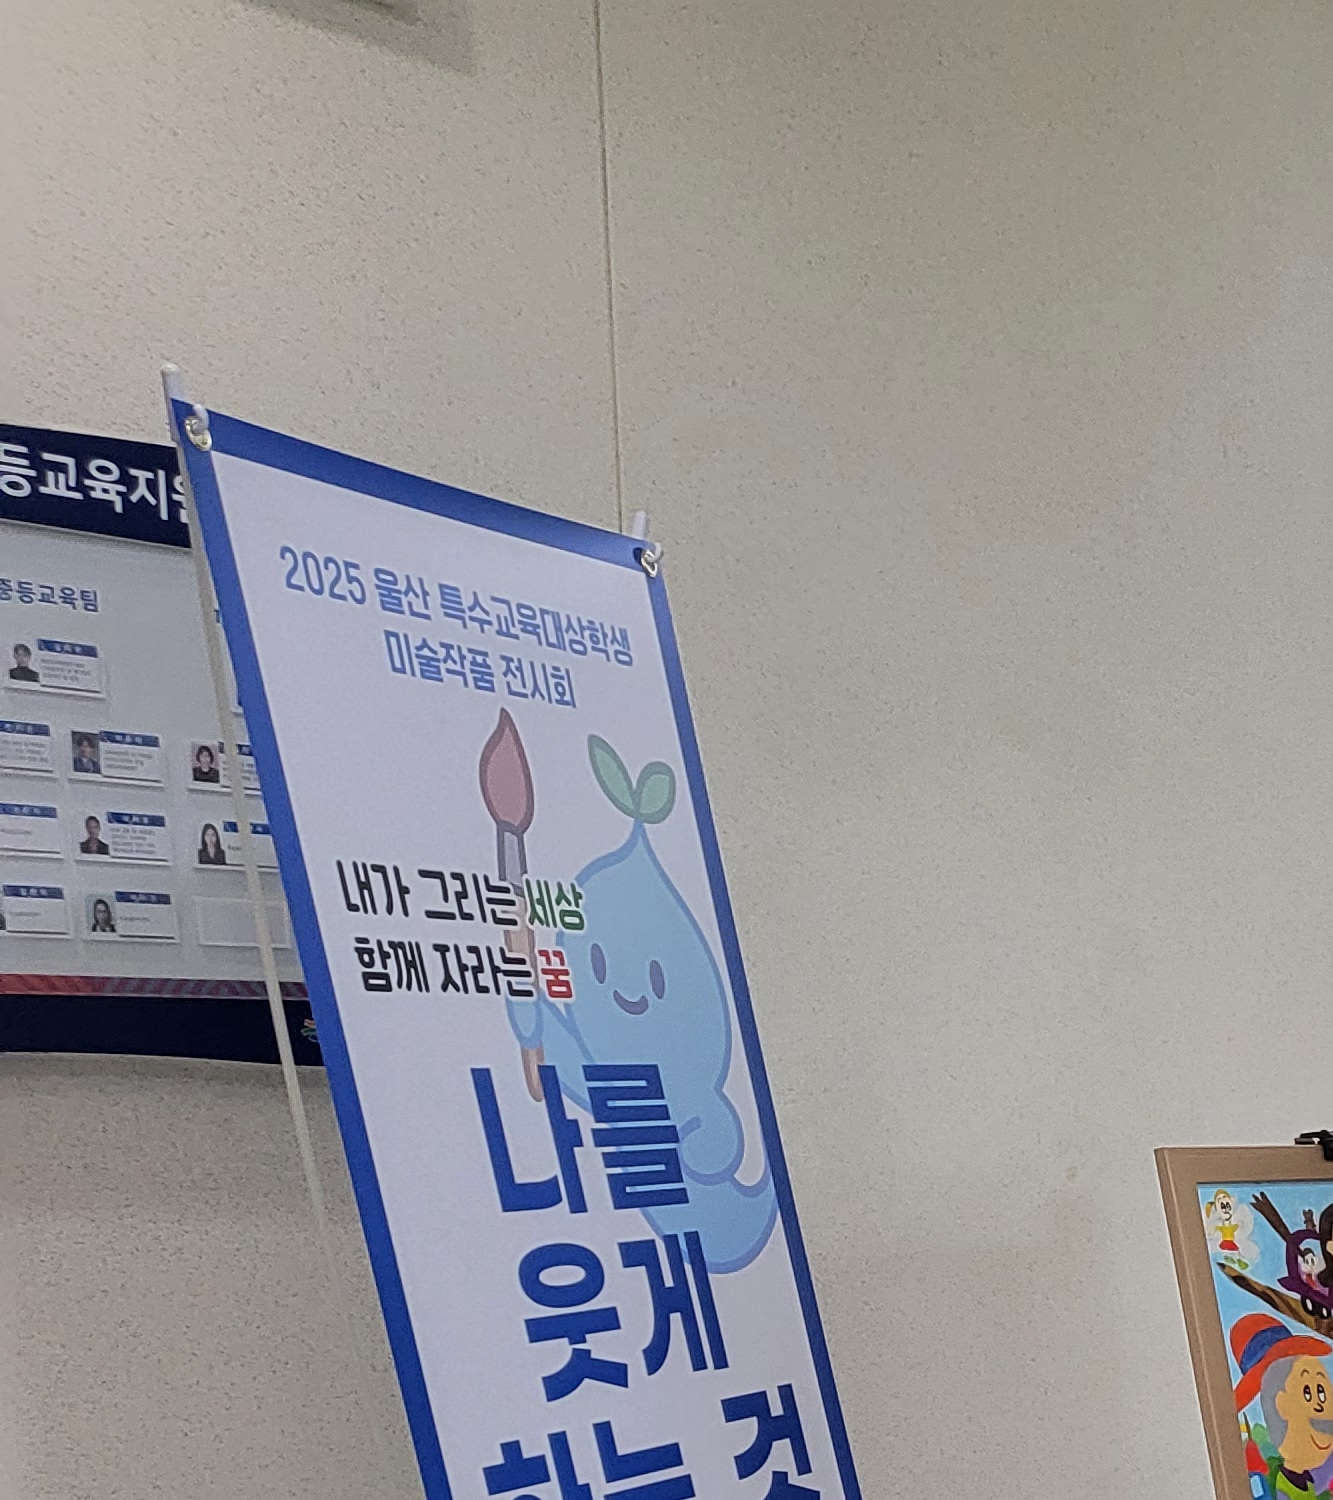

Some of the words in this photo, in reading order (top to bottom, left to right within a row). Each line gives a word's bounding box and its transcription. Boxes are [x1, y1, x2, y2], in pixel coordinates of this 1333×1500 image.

[280, 545, 366, 605] 2025
[374, 567, 432, 621] 울산
[438, 582, 633, 667] 특수교육대상학생
[384, 629, 496, 693] 미술작품
[500, 655, 577, 709] 전시회
[336, 860, 410, 917] 내가
[418, 869, 518, 926] 그리는
[525, 877, 585, 931] 세상
[354, 936, 430, 993] 함께
[432, 943, 534, 997] 자라는
[538, 949, 573, 998] 꿈
[470, 1063, 692, 1215] 나를
[518, 1230, 730, 1403] 웃게
